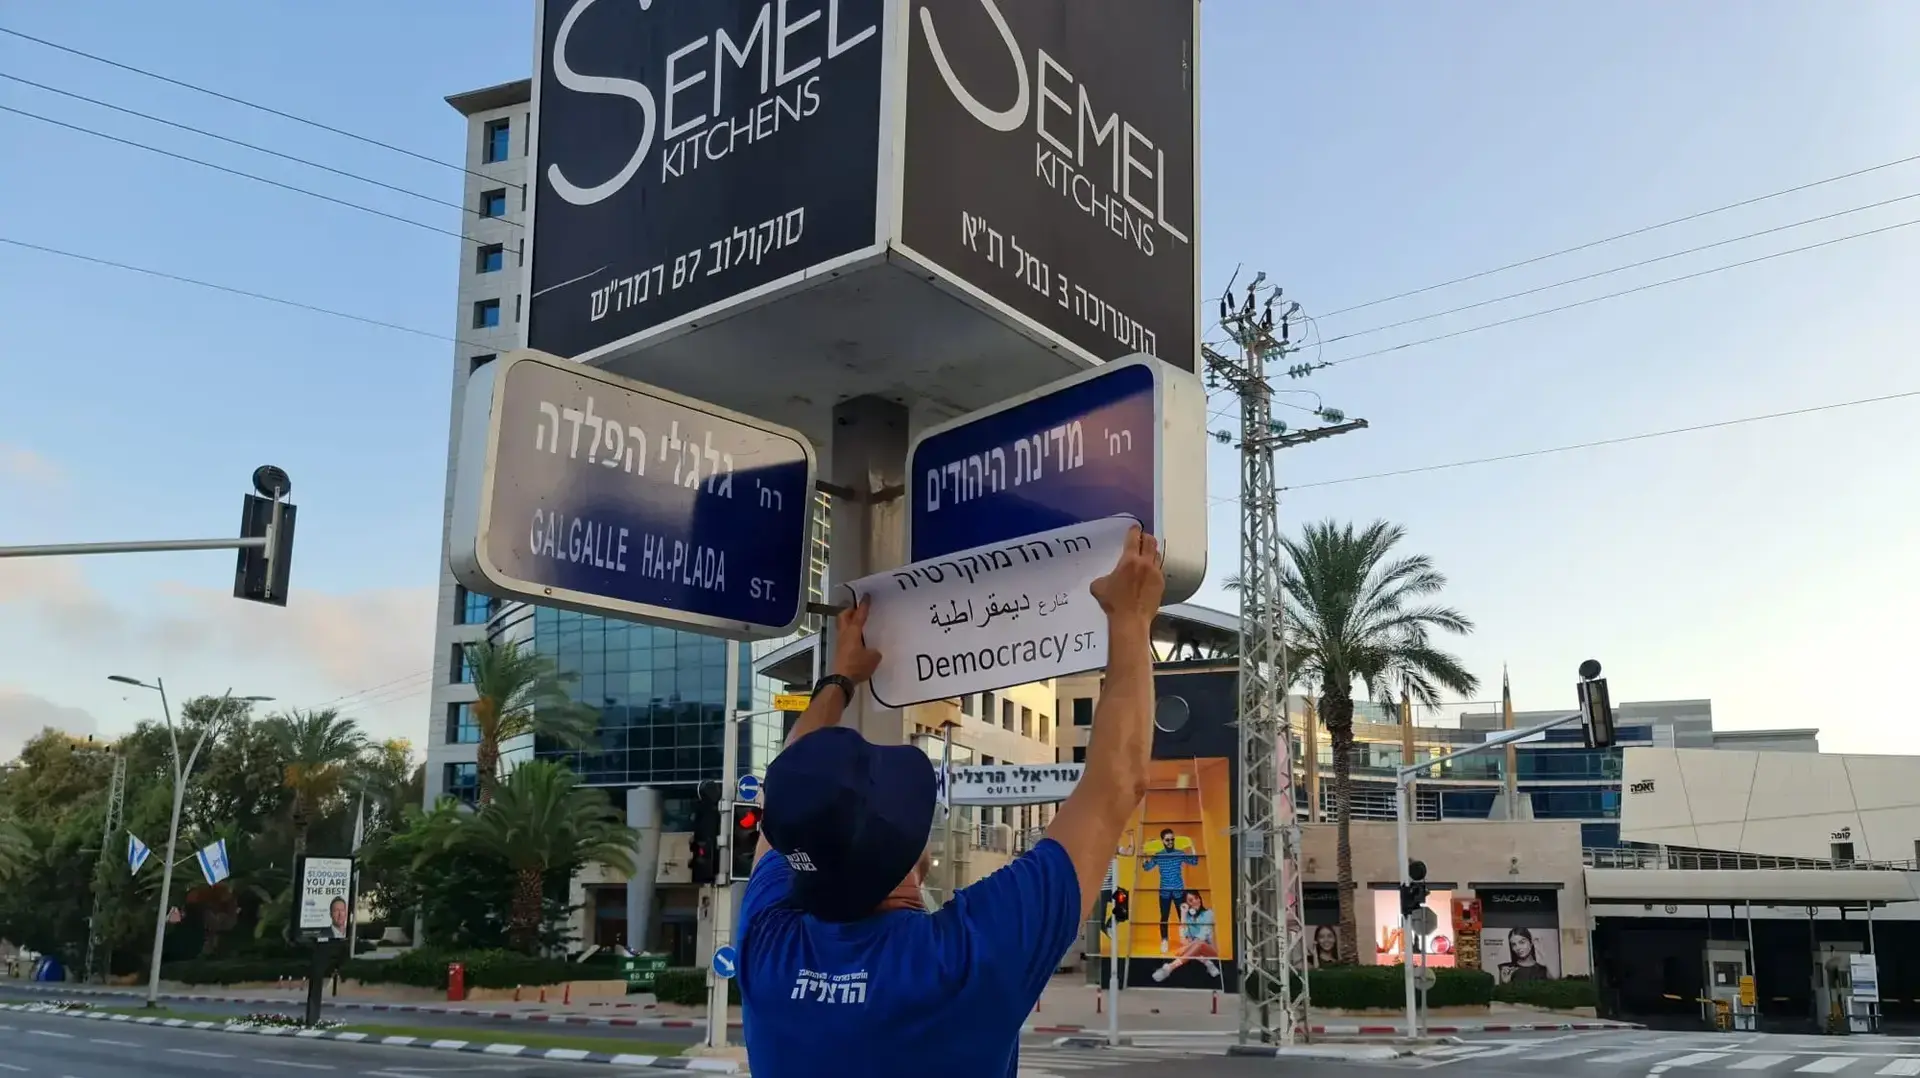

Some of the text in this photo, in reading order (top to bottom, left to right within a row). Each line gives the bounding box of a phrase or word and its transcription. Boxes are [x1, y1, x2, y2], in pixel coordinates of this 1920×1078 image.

[548, 0, 877, 205] SEMEL
[661, 76, 821, 184] KITCHENS
[1036, 142, 1155, 256] KITCHENS
[706, 207, 805, 276] סוקולוב
[672, 248, 701, 290] 87
[961, 211, 1157, 357] התערוכה 3 נמל ת"א
[535, 396, 783, 511] רח' גלגלי הפלדה
[927, 420, 1132, 513] רח' מדינת היהודים
[530, 508, 777, 601] GALGALLE HA-PLADA ST.
[892, 536, 1092, 591] רח' הדמוקרטיה
[930, 592, 1069, 634] شارع ديمقراطية
[916, 631, 1096, 682] Democracy ST.
[986, 785, 1037, 794] OUTLET
[1012, 767, 1080, 783] עזריאלי
[1630, 782, 1655, 792] זאפה
[306, 878, 347, 886] YOU ARE
[306, 887, 346, 895] THE BEST
[1491, 894, 1541, 903] SACARA
[791, 978, 867, 1004] הרצליה
